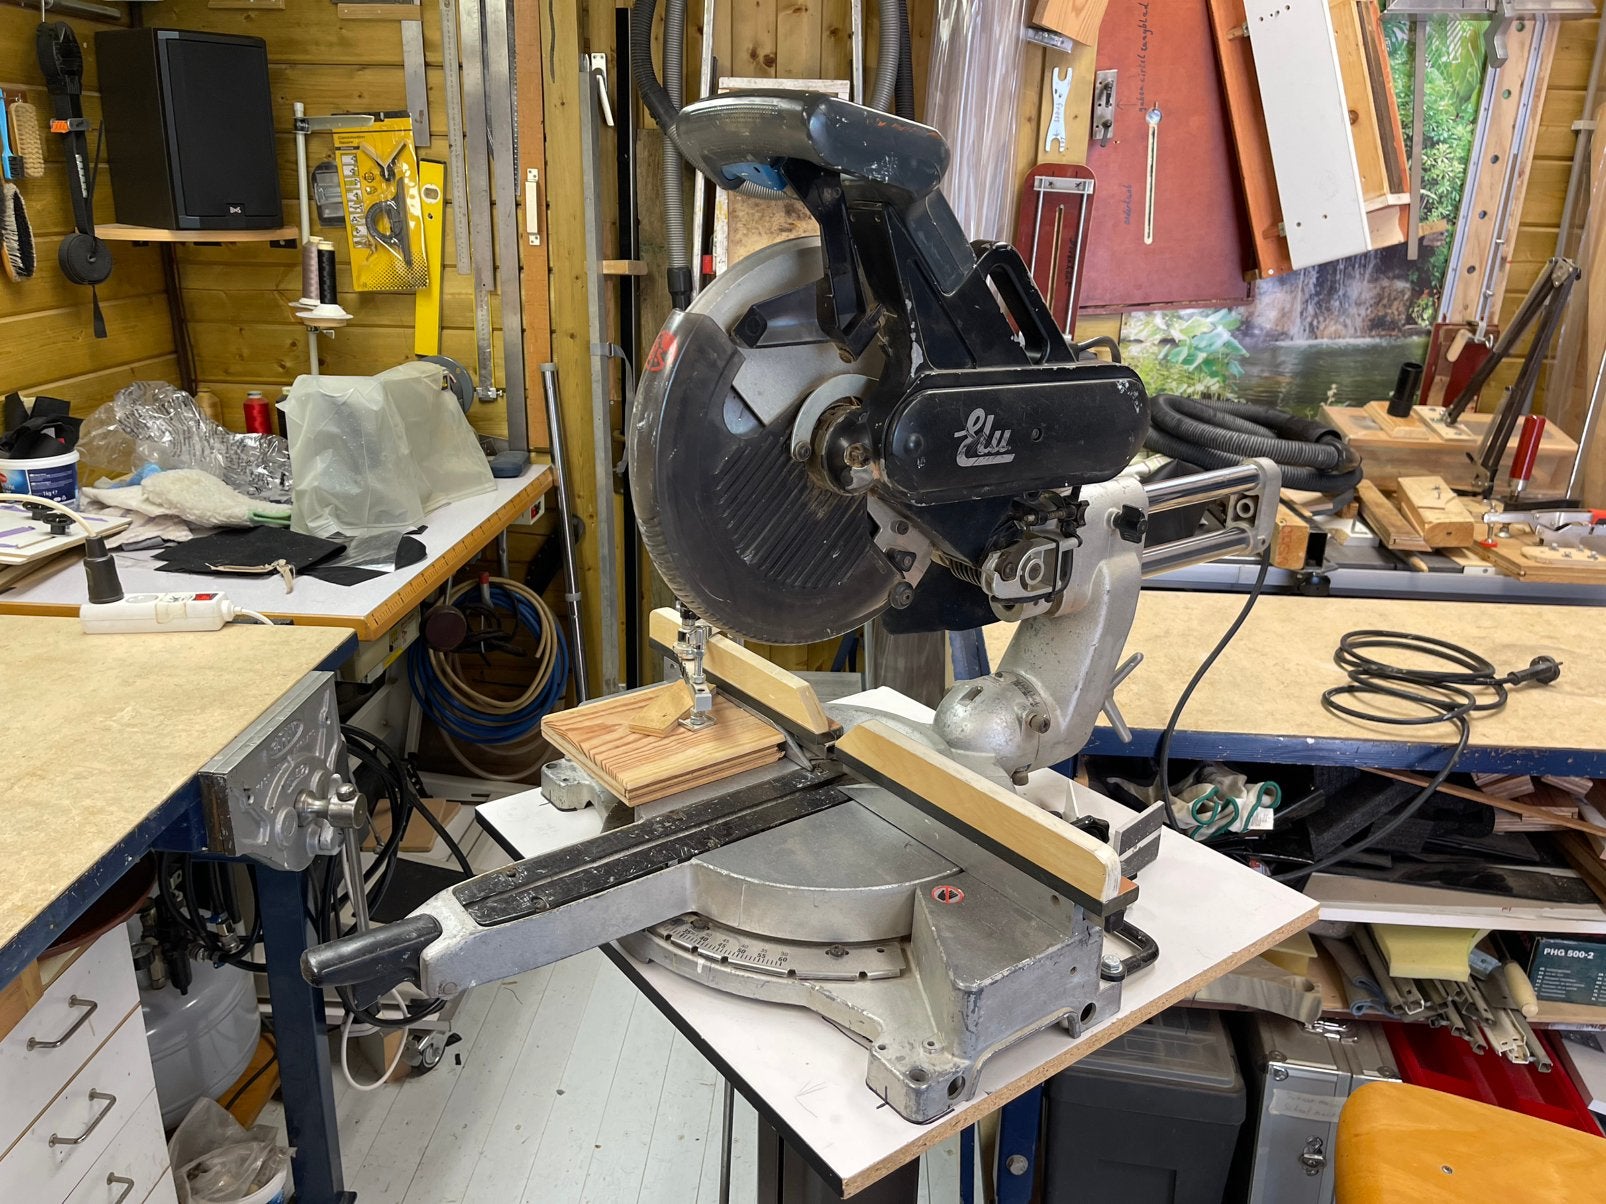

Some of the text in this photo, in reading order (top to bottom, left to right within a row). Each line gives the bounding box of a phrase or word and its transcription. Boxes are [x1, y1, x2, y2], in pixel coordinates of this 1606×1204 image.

[954, 407, 1015, 467] Elu
[1544, 948, 1594, 959] PHG 500-2
